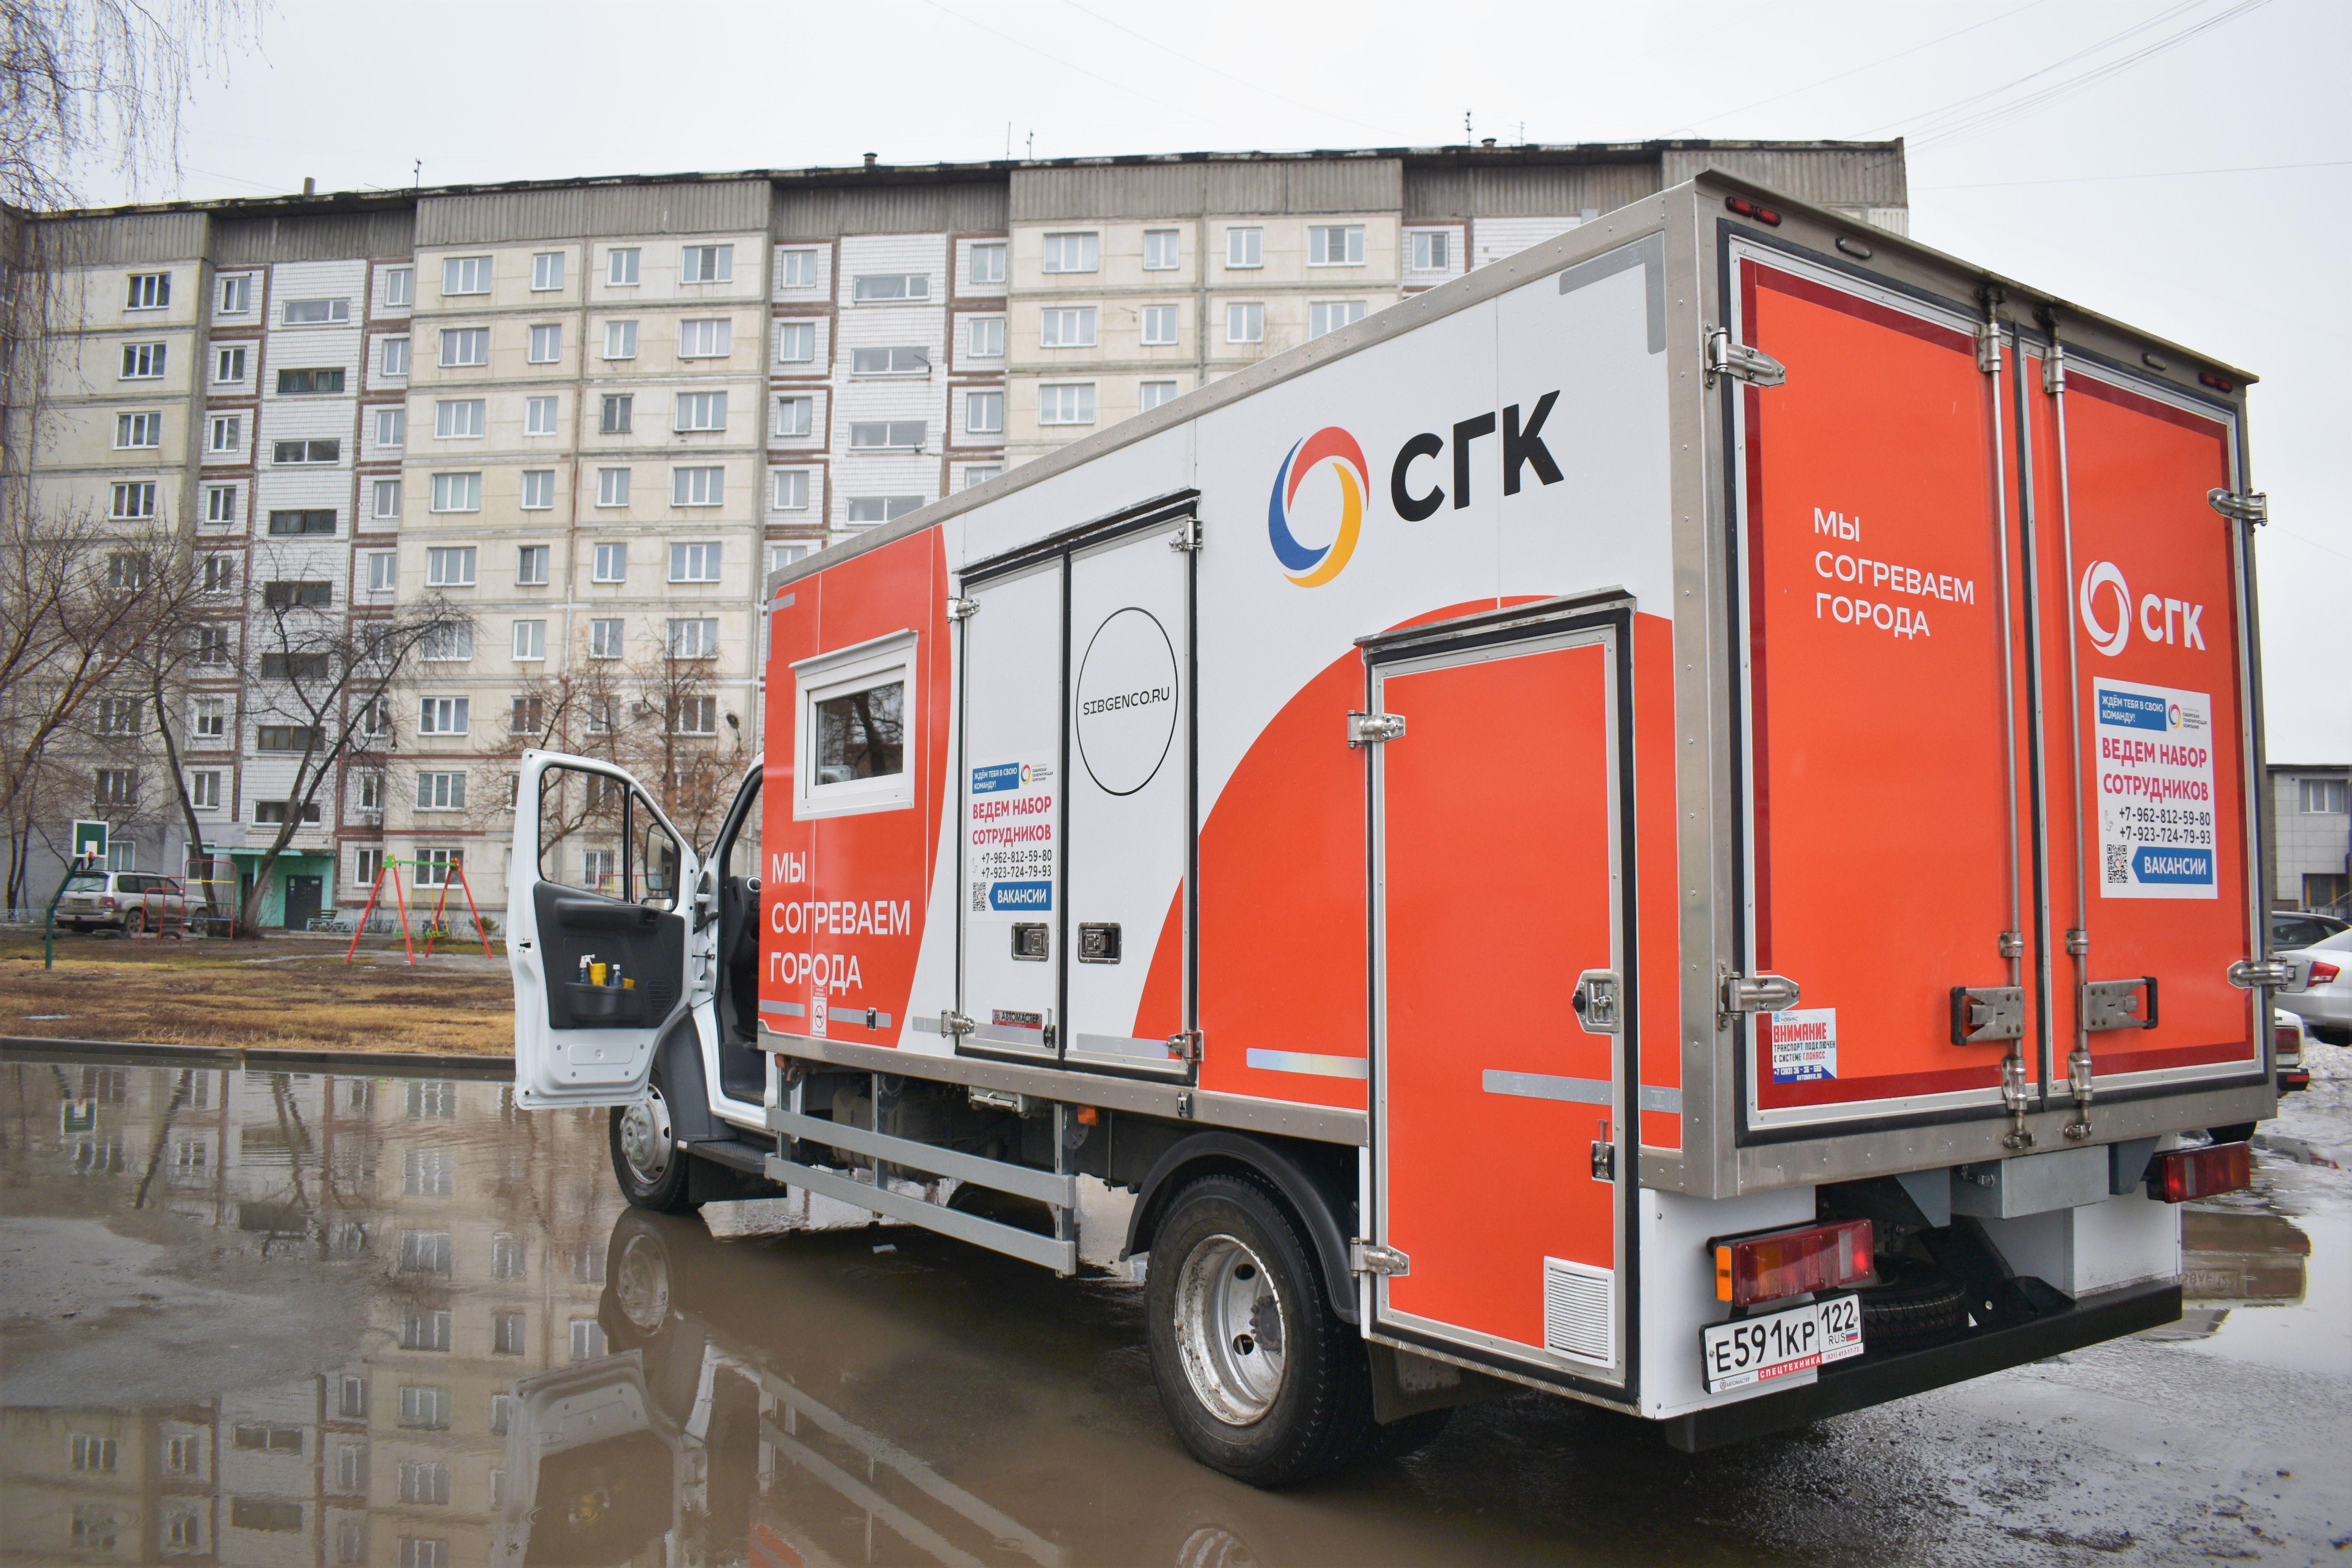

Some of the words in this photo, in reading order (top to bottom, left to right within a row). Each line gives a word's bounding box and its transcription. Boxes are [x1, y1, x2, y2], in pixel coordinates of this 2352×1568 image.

[1391, 390, 1564, 521] СГК
[1814, 507, 1860, 542] МЫ
[1815, 551, 1974, 605] СОГРЕВАЕМ
[1816, 592, 1930, 640] ГОРОДА
[2140, 593, 2206, 651] СГК
[1083, 686, 1169, 715] SIBGENCO.RU
[2102, 695, 2122, 708] ЖДЁМ
[2123, 699, 2138, 709] ТЕБЯ
[2140, 701, 2143, 710] В
[2145, 702, 2163, 712] СВОЮ
[2102, 710, 2135, 724] КОМАНДУ!
[2102, 737, 2155, 767] ВЕДЕМ
[2160, 744, 2207, 768] НАБОР
[974, 769, 987, 780] ЖДЁМ
[1003, 767, 1017, 776] СВОЮ
[974, 780, 996, 790] КОМАНДУ!
[2103, 773, 2208, 803] СОТРУДНИКОВ
[973, 800, 1009, 823] ВЕДЕМ
[1013, 796, 1052, 815] НАБОР
[2120, 806, 2210, 826] +7-962-812-59-80
[973, 824, 1051, 848] СОТРУДНИКОВ
[2120, 826, 2211, 844] +7-923-724-79-93
[982, 849, 1052, 864] +7-962-812-59-80
[2144, 856, 2206, 875] ВАКАНСИИ
[772, 851, 806, 884] МЫ
[982, 865, 1051, 878] +7-923-724-79-93
[998, 889, 1046, 903] ВАКАНСИИ
[772, 900, 910, 935] СОГРЕВАЕМ
[771, 952, 862, 996] ГОРОДА
[1002, 1011, 1039, 1024] АВТОМАСТЕР
[1773, 1022, 1826, 1043] ВНИМАНИЕ
[1774, 1043, 1803, 1053] ТРАНСПОРТ
[1805, 1041, 1835, 1051] ПОДКЛЮЧЕН
[1779, 1053, 1801, 1062] СИСТЕМЕ
[1803, 1051, 1825, 1060] ГЛОНАСС
[1715, 1319, 1815, 1372] Е591КР
[1820, 1301, 1854, 1334] 122
[1828, 1333, 1845, 1345] RUS
[1838, 1347, 1859, 1357] 413-17-73
[1760, 1356, 1820, 1378] СПЕЦТЕХНИКА
[1726, 1376, 1750, 1387] АВТОМАСТЕР
